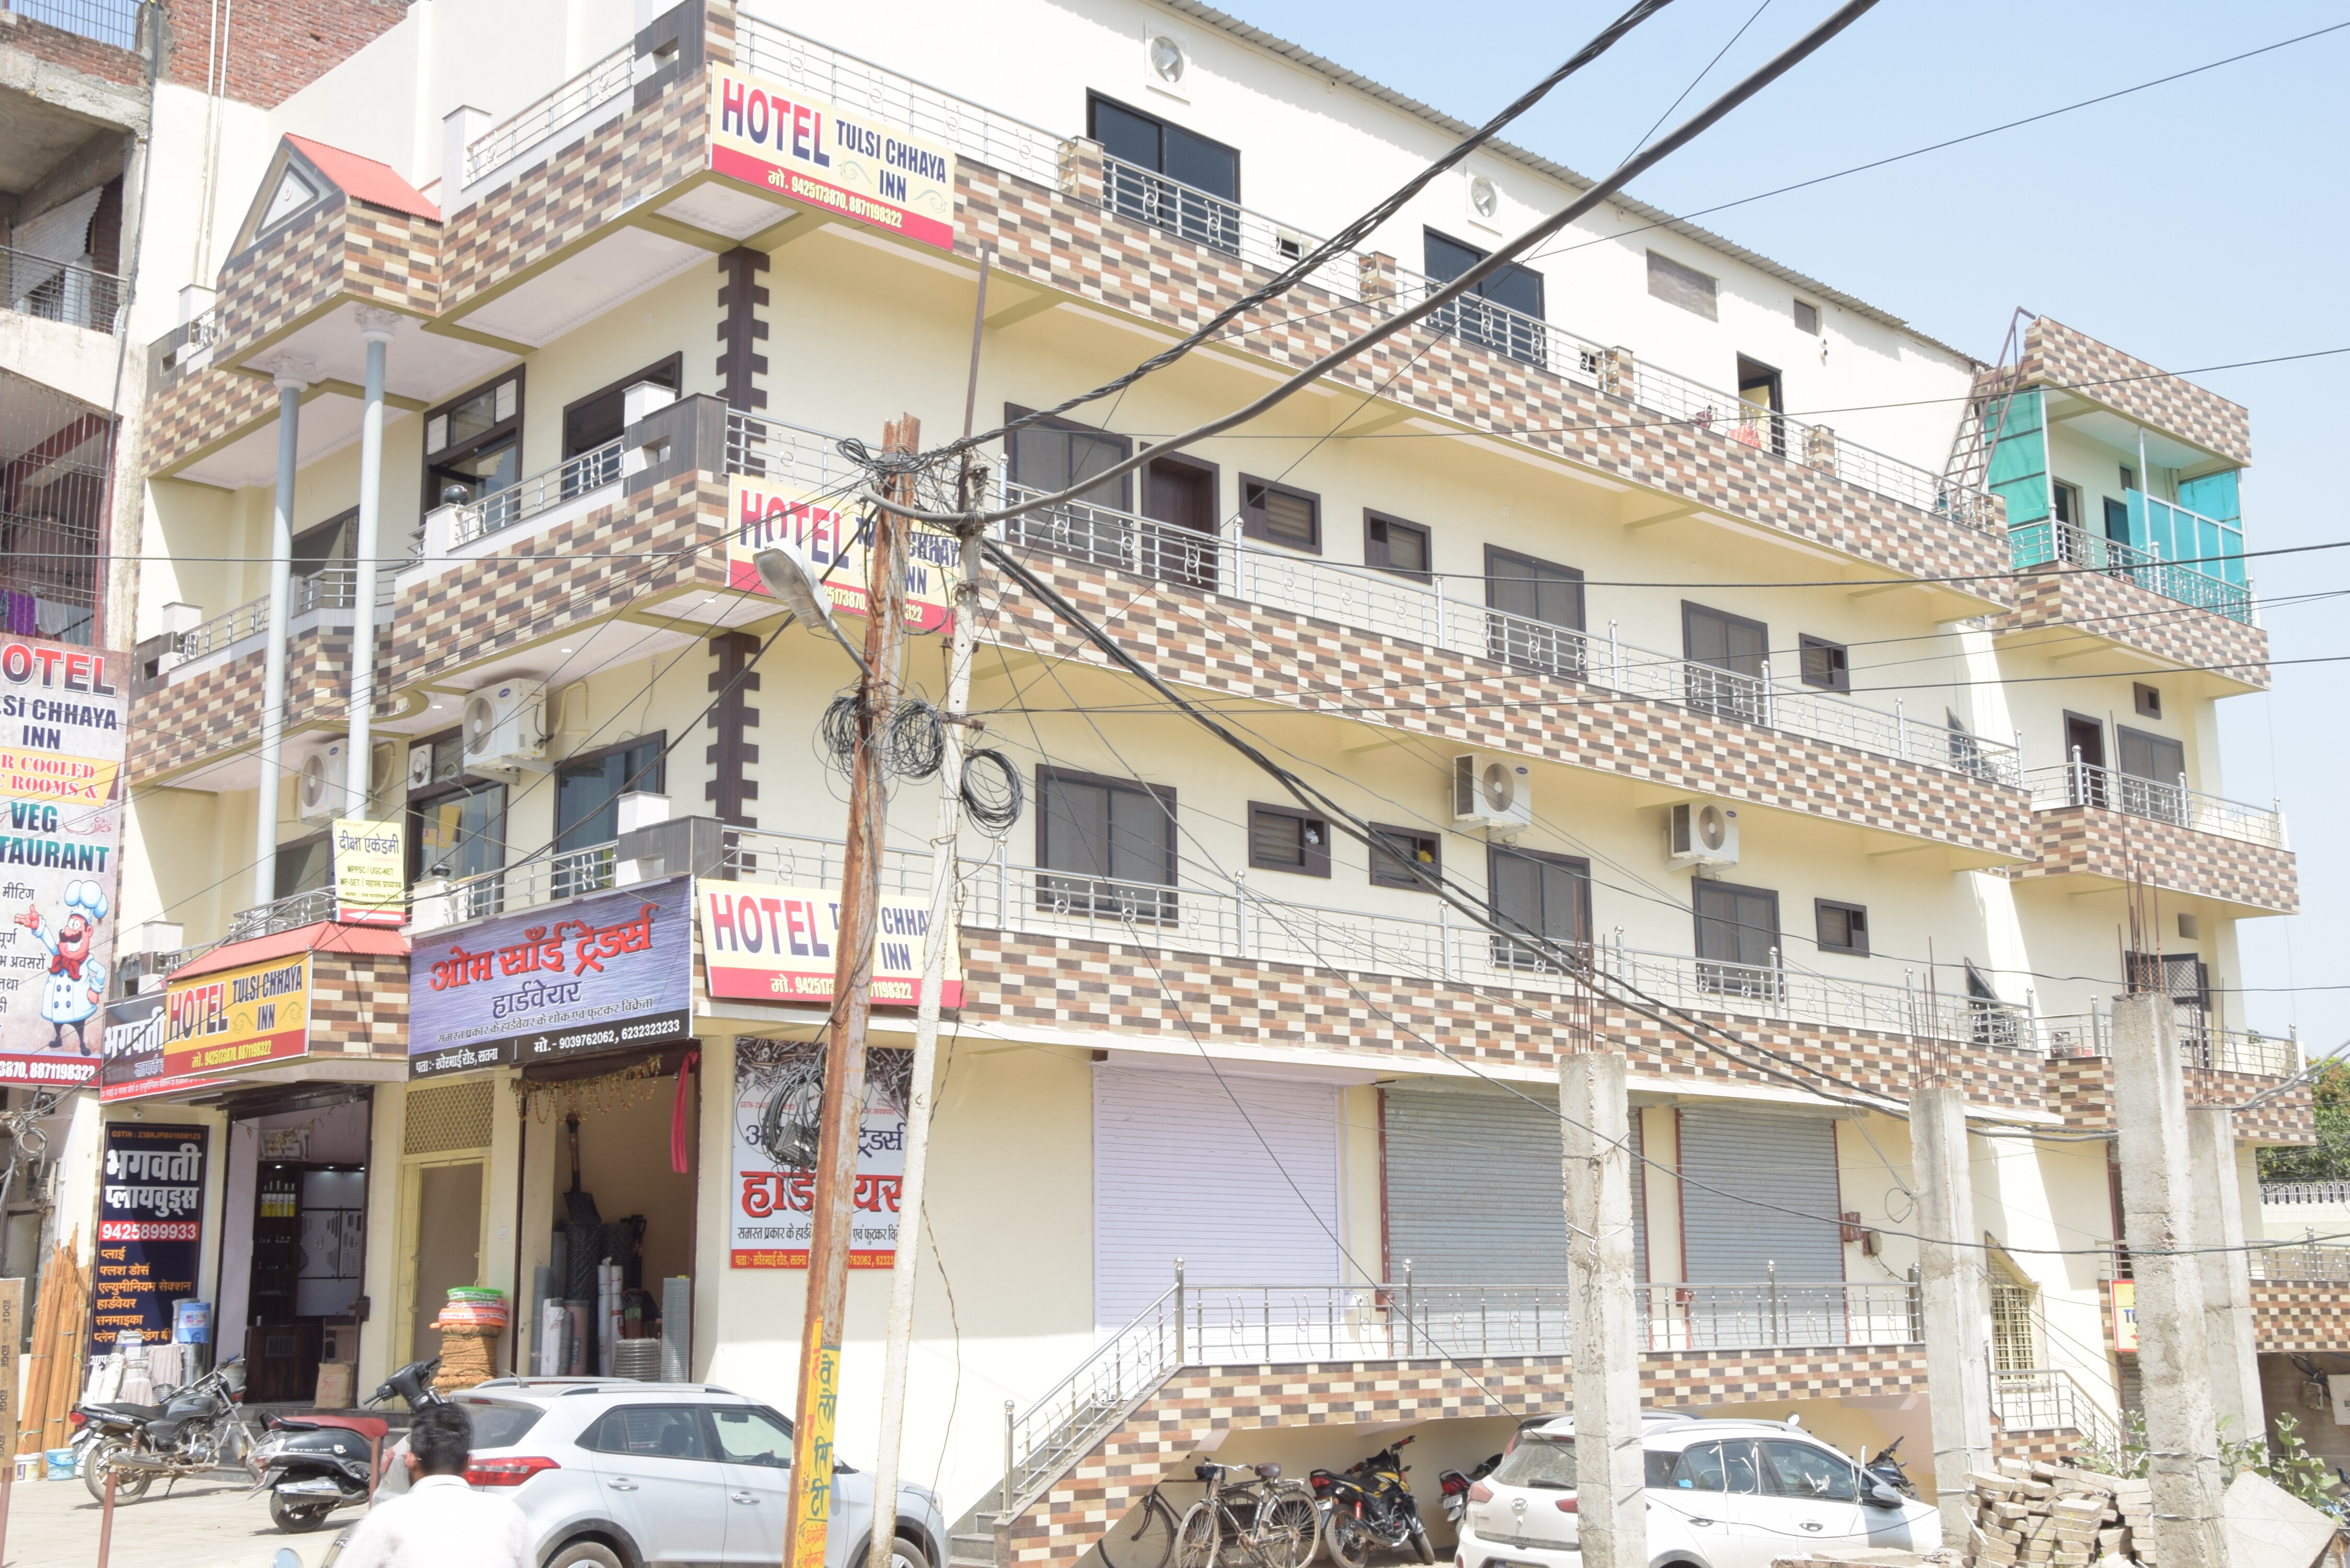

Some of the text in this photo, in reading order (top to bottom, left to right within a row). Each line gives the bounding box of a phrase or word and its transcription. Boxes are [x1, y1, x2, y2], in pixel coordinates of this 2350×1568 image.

[722, 78, 830, 168] HOTEL
[836, 119, 947, 184] TULSI CHHAYA
[768, 169, 789, 189] मो.
[849, 196, 902, 228] 8871198322
[880, 169, 906, 203] INN
[740, 490, 849, 569] HOTEL
[907, 566, 926, 595] NN
[1, 643, 117, 697] OTEL
[32, 698, 118, 731] CHHAYA
[22, 725, 61, 751] INN
[20, 756, 95, 779] COOLED
[11, 775, 78, 798] ROOMS
[85, 785, 98, 800] &
[10, 801, 58, 833] VEG
[0, 837, 110, 873] TAURANT
[339, 829, 361, 851] दीक्षा
[364, 833, 399, 855] एकेडमी
[370, 867, 394, 875] UGC-NET
[710, 893, 830, 958] HOTEL
[881, 907, 929, 936] CHHA
[10, 953, 47, 970] अवसरों
[430, 946, 494, 991] ओम
[574, 903, 659, 976] ट्रेडर्स
[881, 942, 912, 971] INN
[233, 965, 302, 1004] TULSI CHHAYA
[770, 973, 793, 993] मो.
[169, 984, 228, 1042] HOTEL
[492, 979, 582, 1019] हार्डवेयर
[105, 1006, 166, 1057] भगवती
[258, 1004, 275, 1031] INN
[437, 997, 653, 1044] समस्त प्रकार के हार्डवेयर के थोक एवं फुटकर विक्रेता
[478, 1048, 498, 1063] सतना
[559, 1030, 619, 1050] 9039762062,
[621, 1019, 680, 1040] 6232323233
[0, 1061, 95, 1082] 3870, 8871198322
[192, 1052, 203, 1068] मो.
[107, 1143, 202, 1181] भगवती
[105, 1186, 200, 1217] प्लायवुड्स
[102, 1224, 197, 1240] 9425899933
[738, 1227, 762, 1239] समस्त
[764, 1227, 785, 1240] प्रकार
[787, 1223, 794, 1238] के
[853, 1225, 863, 1242] एवं
[865, 1228, 886, 1245] फुटकर
[101, 1246, 126, 1260] प्लाई
[790, 1254, 807, 1265] सतना
[849, 1254, 874, 1266] 762062,
[100, 1262, 150, 1276] फ्लश डोर्स
[98, 1279, 192, 1295] एल्युमीनियम सेक्शन
[97, 1297, 137, 1310] हार्डवेयर
[96, 1315, 144, 1327] सनमाइका
[94, 1330, 116, 1342] प्लेन
